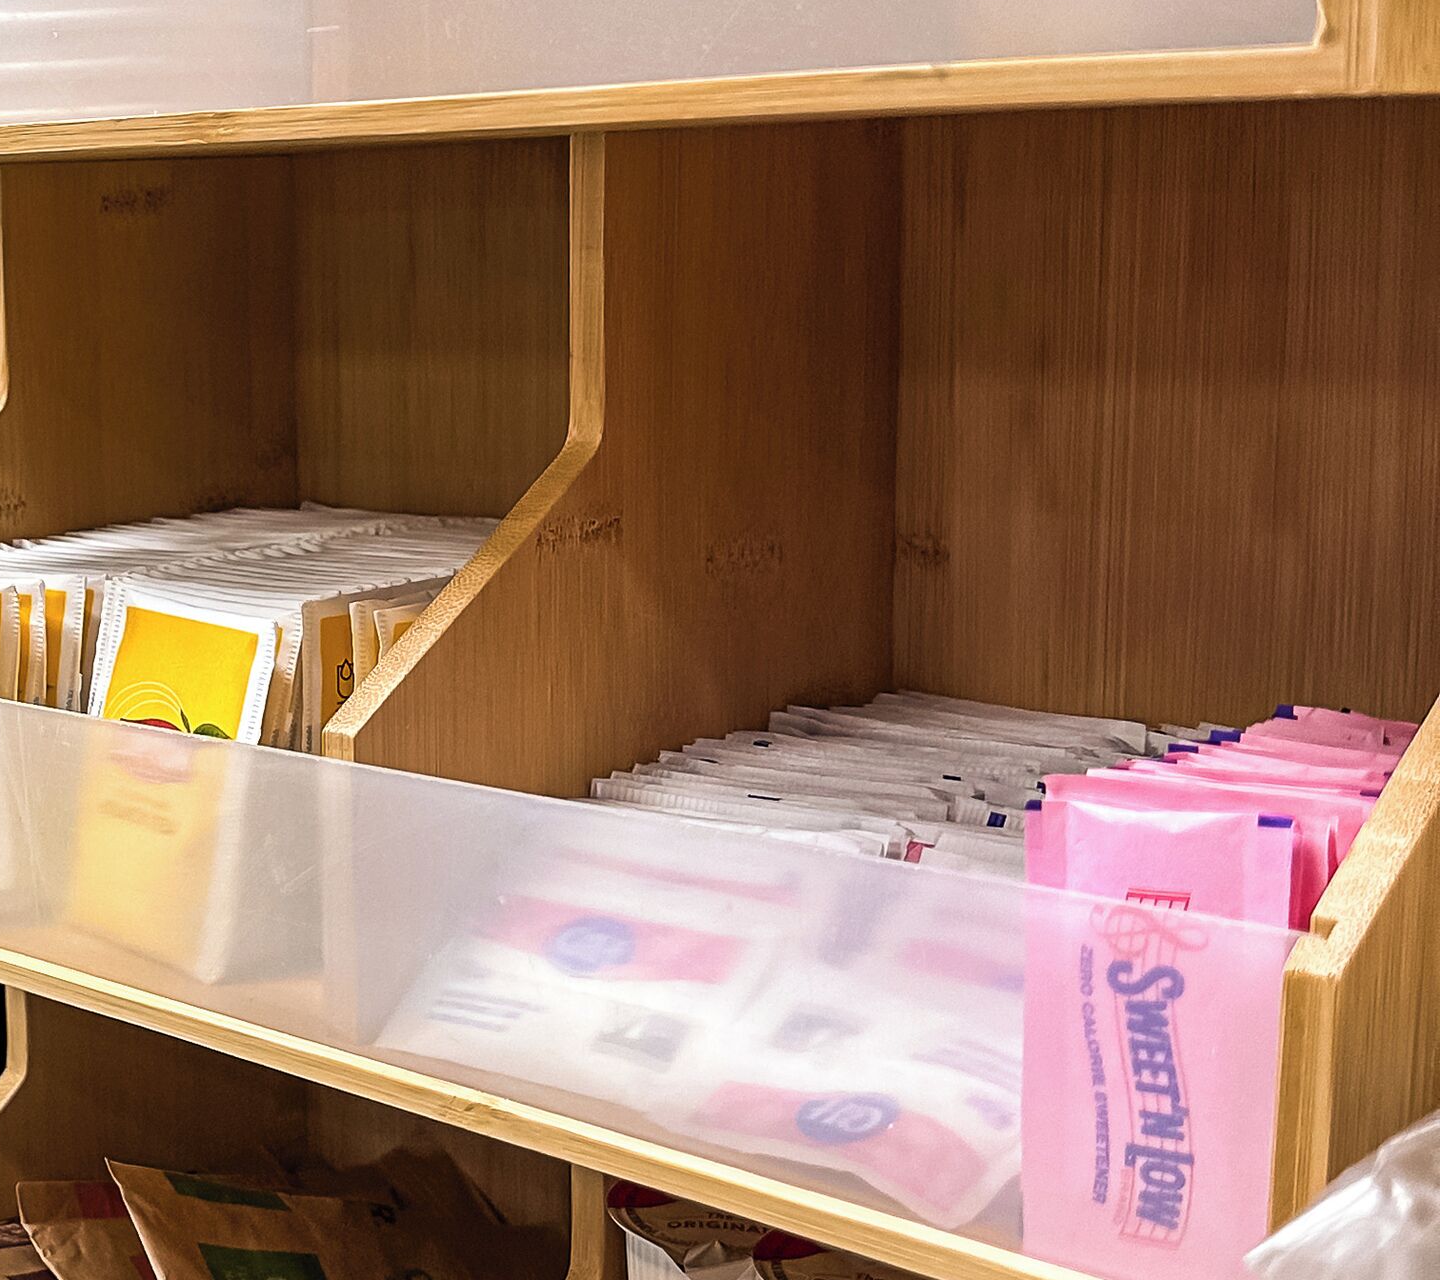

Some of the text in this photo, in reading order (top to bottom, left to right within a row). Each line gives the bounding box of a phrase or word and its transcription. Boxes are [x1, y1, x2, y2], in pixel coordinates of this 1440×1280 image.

[1080, 943, 1111, 1205] ZERO CALORIE SWEETENER
